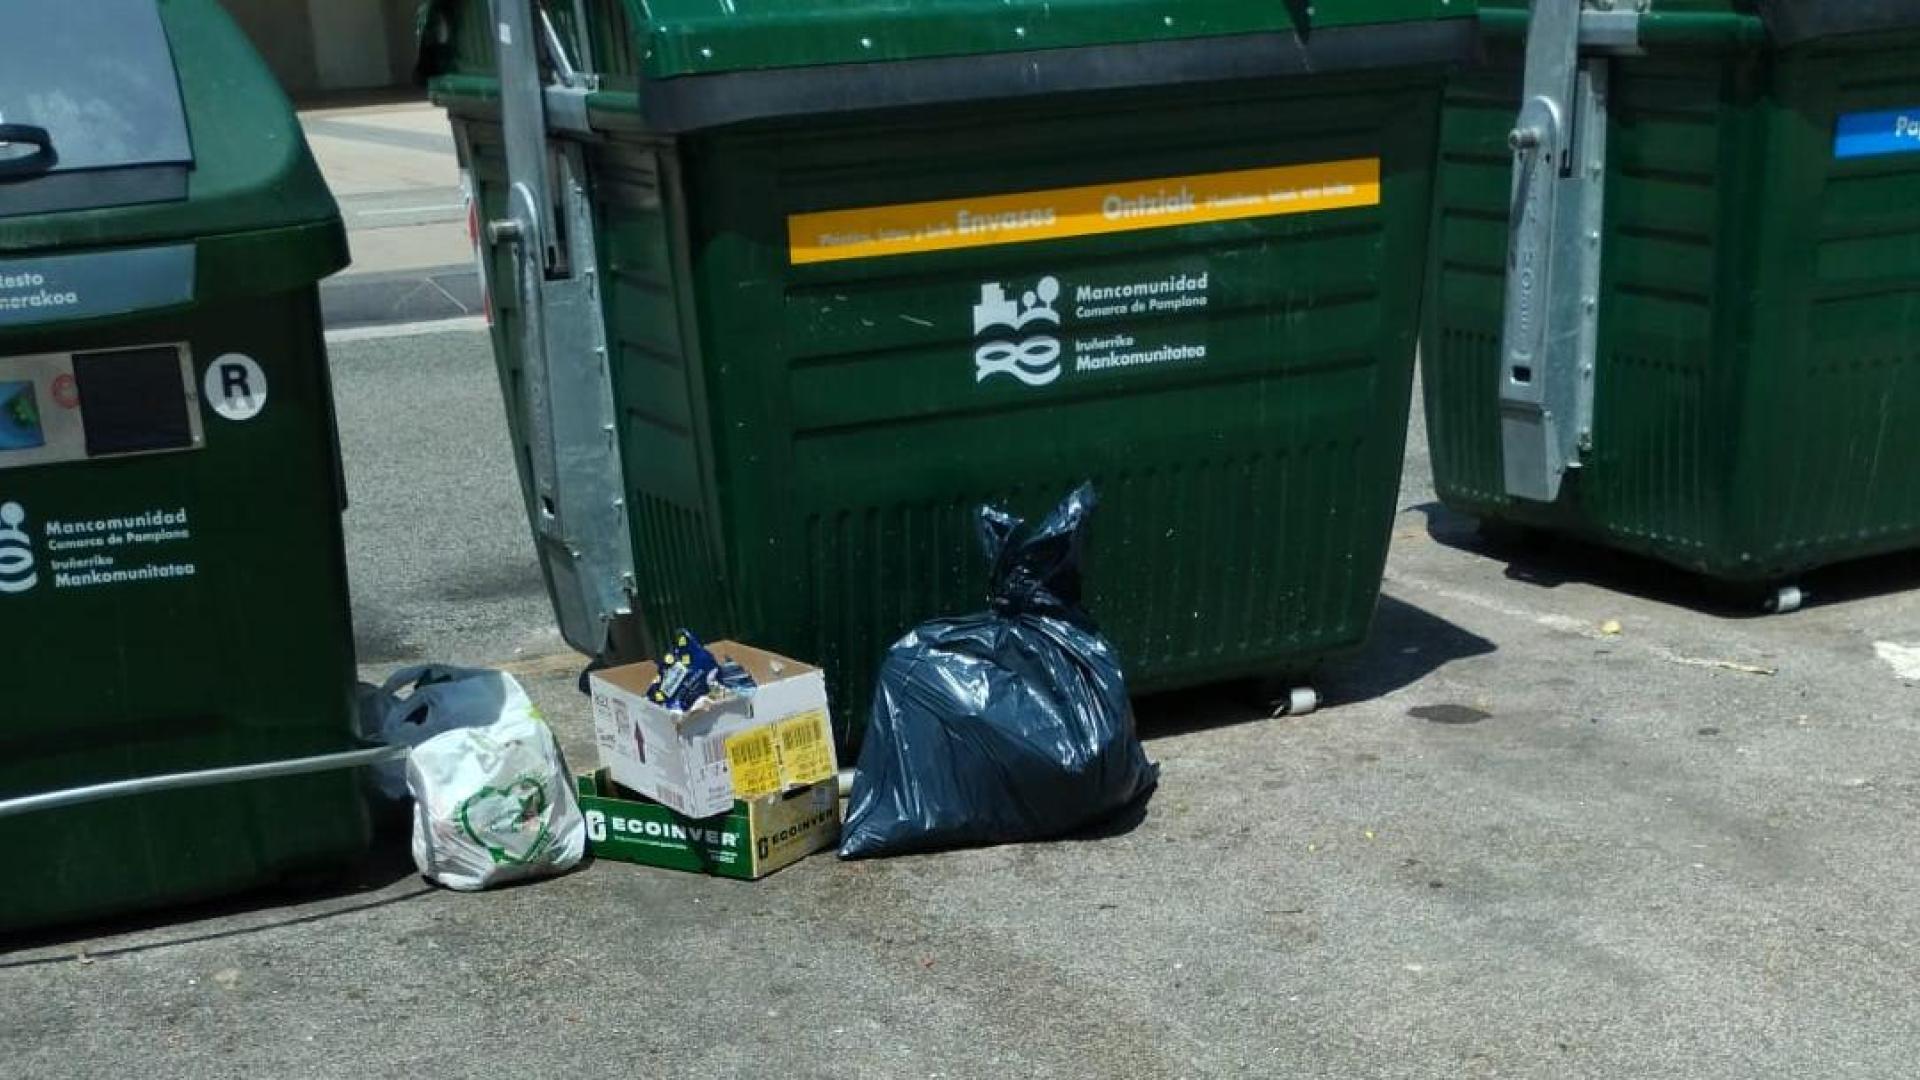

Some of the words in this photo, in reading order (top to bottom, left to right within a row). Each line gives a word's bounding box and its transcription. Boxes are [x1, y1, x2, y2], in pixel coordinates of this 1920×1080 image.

[1076, 271, 1208, 303] Mancomunidad
[1076, 305, 1128, 319] Comarca
[1131, 299, 1146, 313] de
[1149, 295, 1208, 312] Pamplona
[1076, 345, 1206, 371] Mankomunitatea
[220, 363, 251, 399] R
[46, 507, 187, 534] Mancomunidad
[48, 538, 105, 551] Comarca
[107, 533, 123, 545] de
[126, 528, 190, 543] Pamplona
[55, 563, 195, 587] Mankomunitatea
[612, 816, 736, 847] ECOINVER
